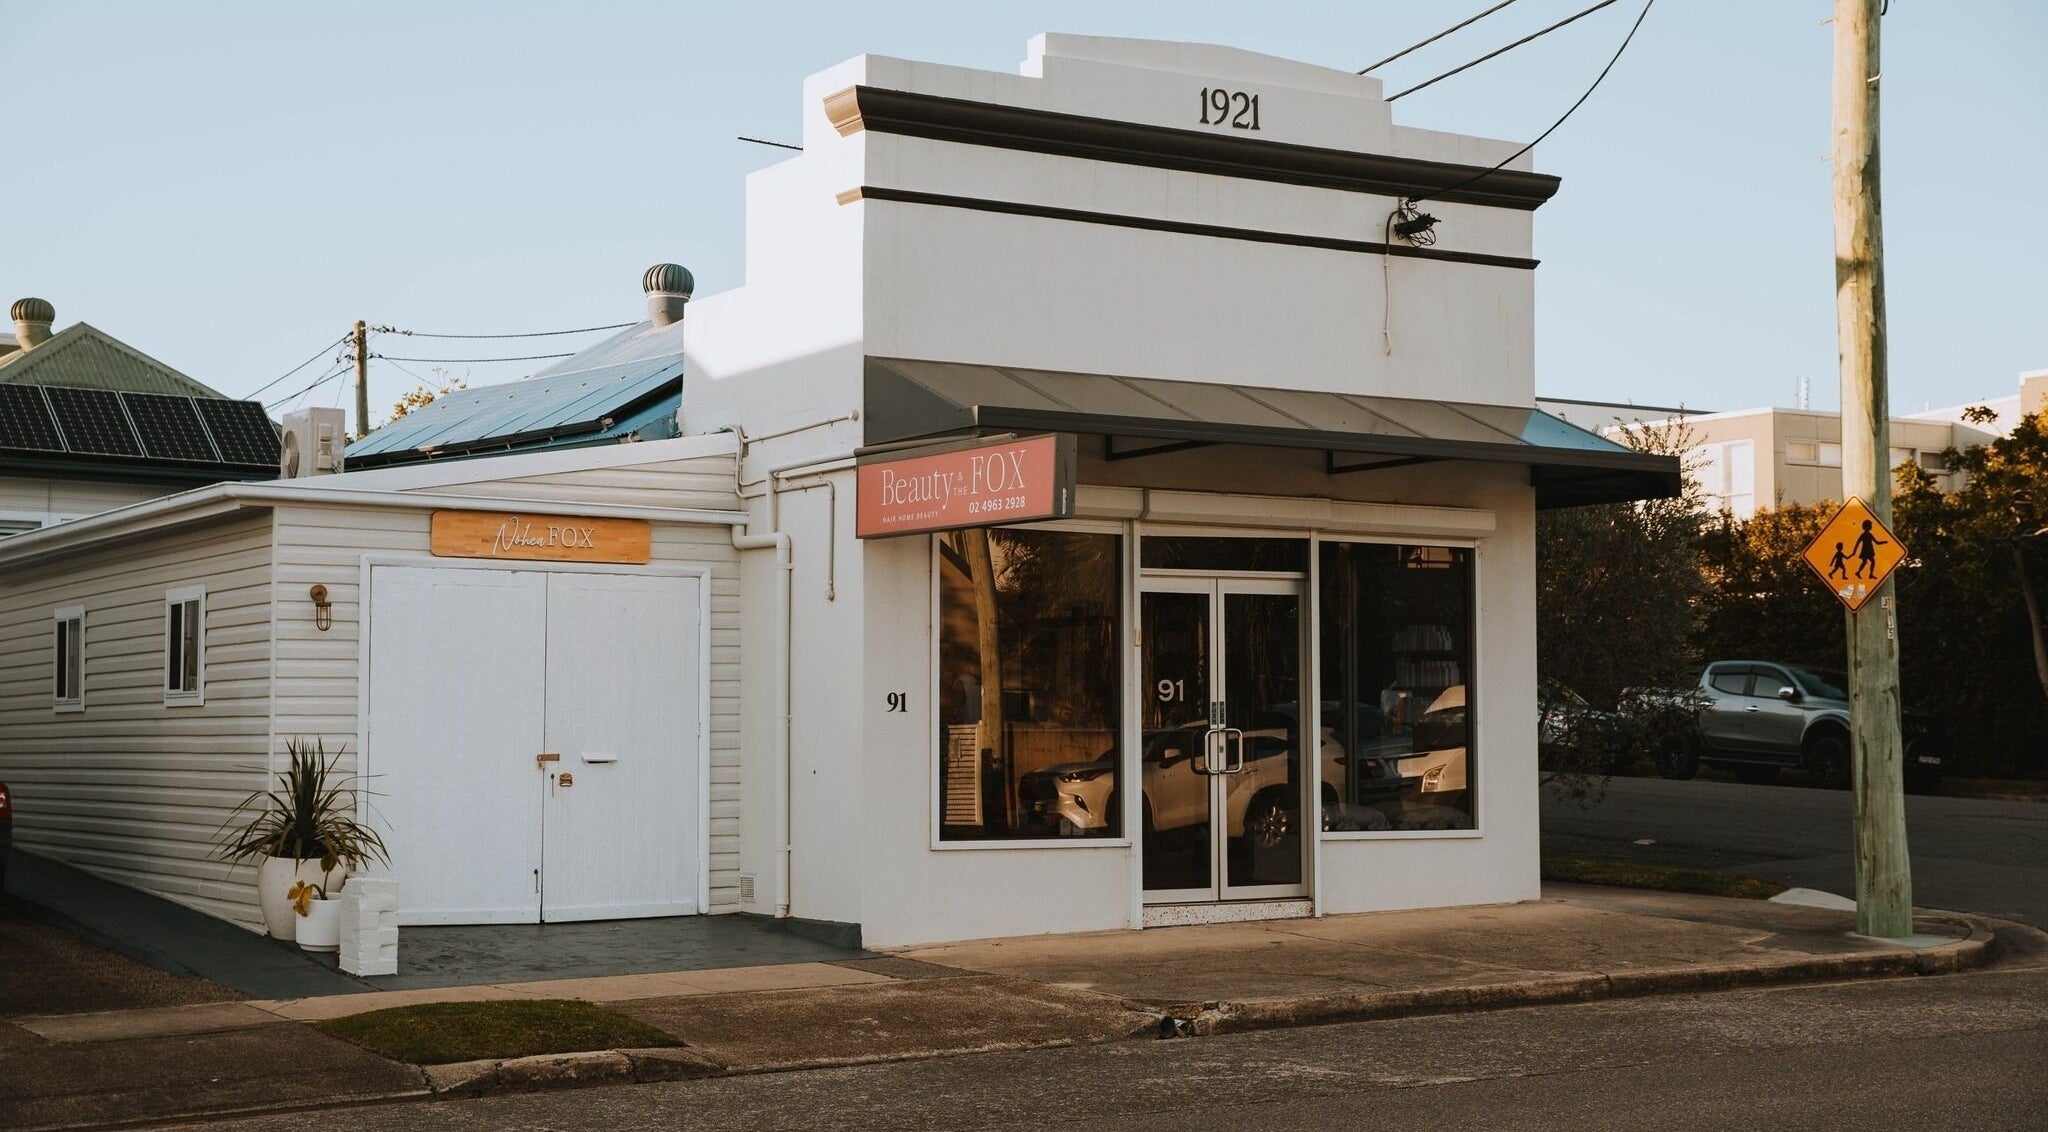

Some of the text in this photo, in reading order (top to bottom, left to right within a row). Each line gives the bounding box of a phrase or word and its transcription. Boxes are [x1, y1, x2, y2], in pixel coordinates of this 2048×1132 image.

[1199, 87, 1260, 130] 1921
[881, 449, 1028, 510] Beauty & THE FOX
[968, 496, 1025, 513] 02 4963 2928
[882, 515, 896, 523] HAIR
[917, 511, 938, 520] BEAUTY
[546, 526, 596, 549] FOX
[1158, 679, 1184, 701] 91
[887, 692, 908, 712] 91
